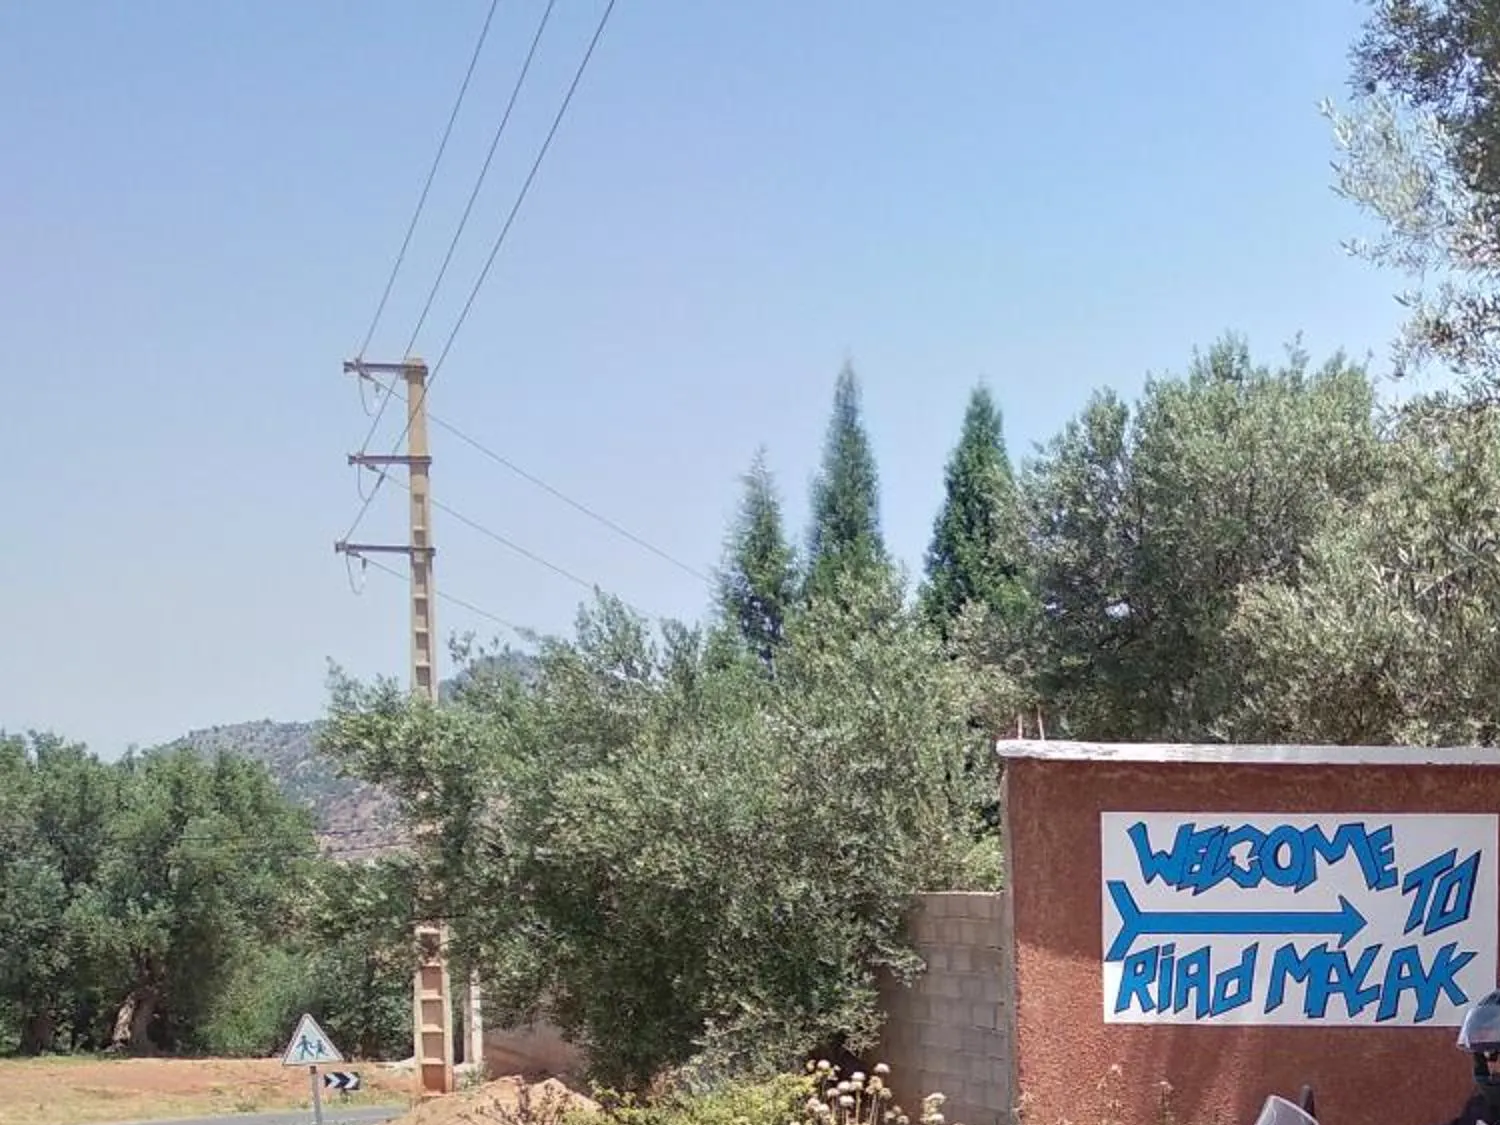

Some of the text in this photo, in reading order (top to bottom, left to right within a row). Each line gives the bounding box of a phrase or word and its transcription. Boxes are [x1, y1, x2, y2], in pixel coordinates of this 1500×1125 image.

[1127, 821, 1482, 936] WELCOME TO
[1264, 941, 1478, 1023] MALAK
